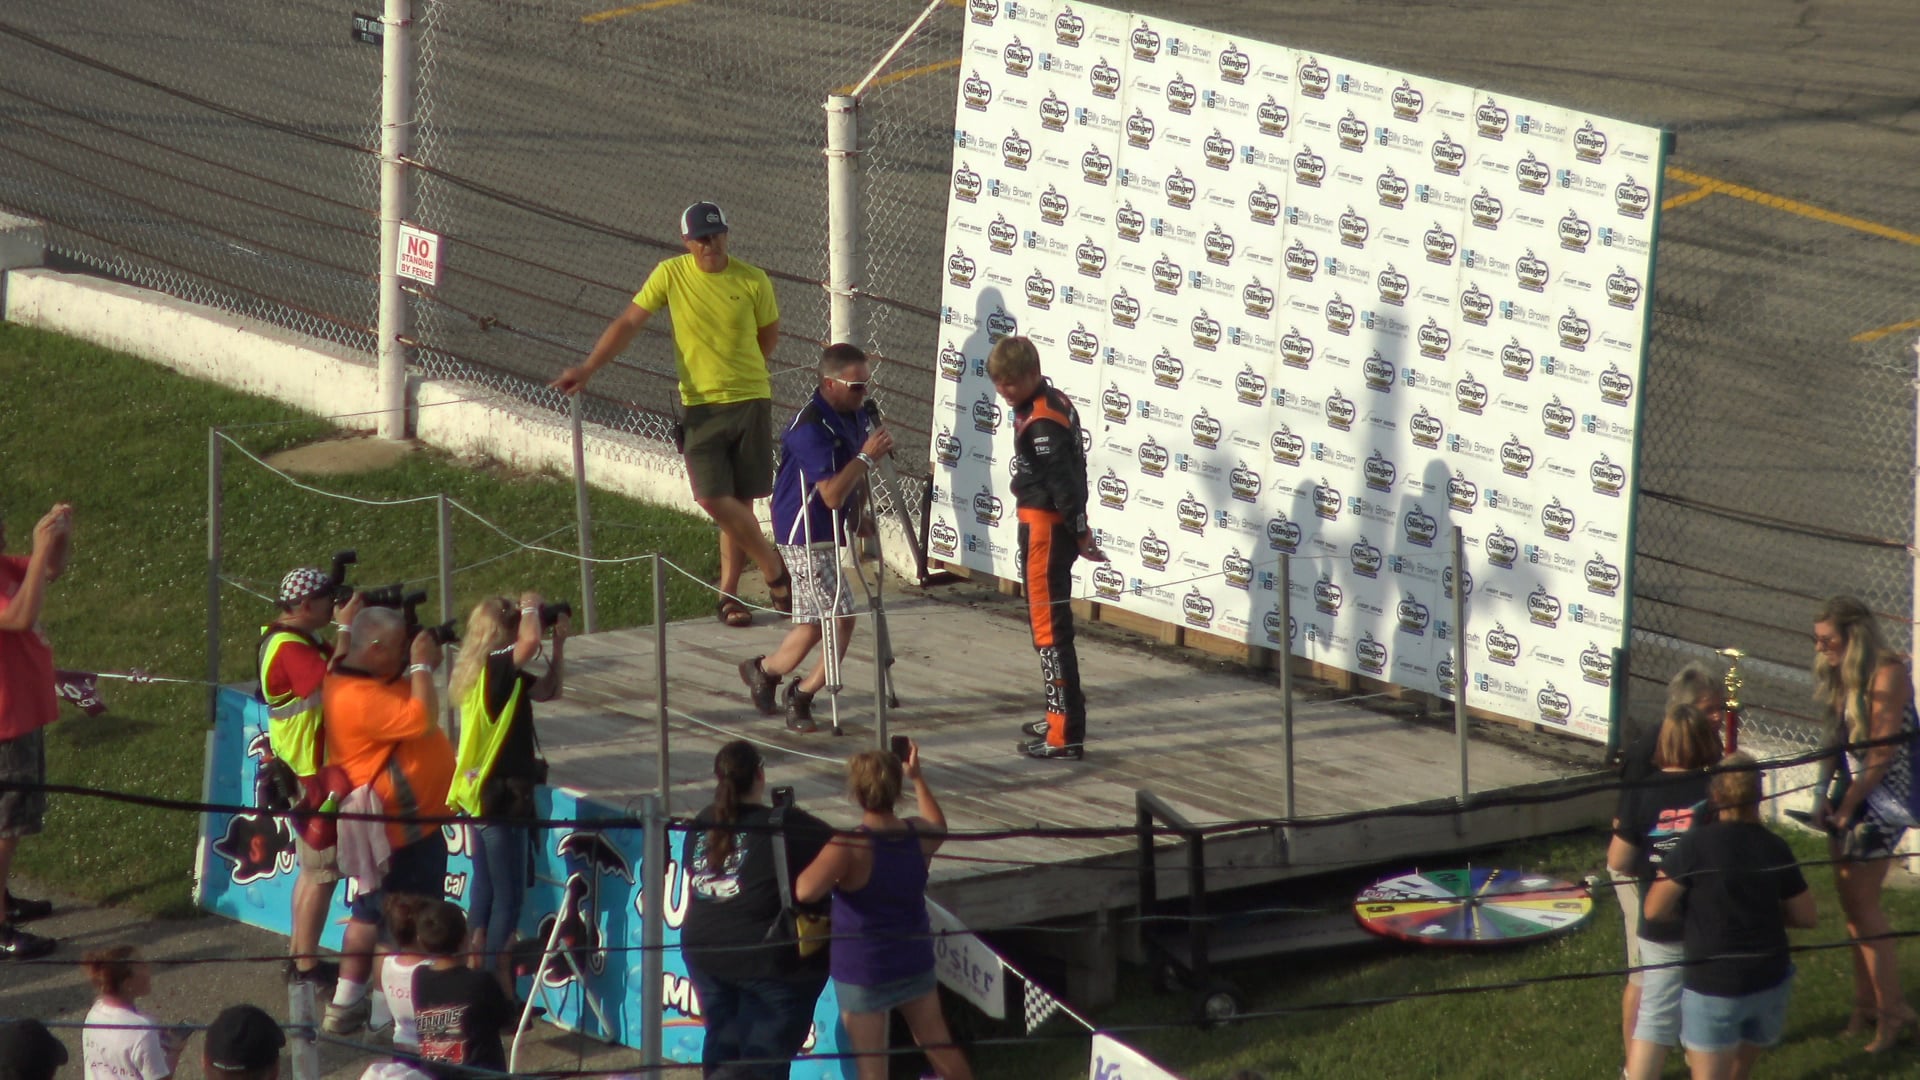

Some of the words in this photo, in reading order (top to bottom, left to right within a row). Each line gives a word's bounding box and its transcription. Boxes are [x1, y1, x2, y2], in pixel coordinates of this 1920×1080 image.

[971, 0, 997, 12] Slinger
[1017, 5, 1028, 18] Billy
[1030, 8, 1049, 21] Brown
[1057, 18, 1081, 32] Slinger
[1133, 34, 1158, 47] Slinger
[1006, 49, 1030, 62] Slinger
[1179, 41, 1190, 54] Billy
[1192, 44, 1212, 57] Brown
[1221, 55, 1247, 69] Slinger
[1093, 70, 1117, 84] Slinger
[1301, 70, 1327, 84] Slinger
[965, 83, 989, 97] Slinger
[1169, 86, 1193, 100] Slinger
[1349, 78, 1361, 91] Billy
[1363, 81, 1383, 94] Brown
[1394, 92, 1420, 107] Slinger
[1042, 103, 1066, 117] Slinger
[1260, 108, 1285, 122] Slinger
[1479, 110, 1505, 125] Slinger
[1088, 111, 1099, 124] Billy
[1101, 114, 1120, 127] Brown
[1339, 123, 1365, 137] Slinger
[1206, 141, 1231, 155] Slinger
[1577, 134, 1603, 148] Slinger
[1004, 142, 1029, 156] Slinger
[1435, 146, 1461, 160] Slinger
[1084, 157, 1109, 171] Slinger
[1254, 149, 1266, 162] Billy
[1268, 153, 1288, 166] Brown
[1296, 158, 1322, 172] Slinger
[1520, 164, 1546, 179] Slinger
[955, 175, 979, 188] Slinger
[1129, 172, 1140, 185] Billy
[1142, 175, 1162, 188] Brown
[1167, 180, 1192, 194] Slinger
[1379, 179, 1405, 194] Slinger
[1570, 173, 1583, 186] Billy
[1585, 176, 1606, 190] Brown
[1000, 182, 1011, 195] Billy
[1013, 186, 1032, 198] Brown
[1429, 188, 1441, 201] Billy
[1443, 191, 1464, 205] Brown
[1618, 188, 1646, 203] Slinger
[1041, 197, 1066, 211] Slinger
[1251, 196, 1276, 210] Slinger
[1473, 200, 1499, 215] Slinger
[1117, 213, 1142, 227] Slinger
[1298, 210, 1310, 223] Billy
[1312, 213, 1332, 227] Brown
[1340, 219, 1366, 233] Slinger
[990, 226, 1014, 240] Slinger
[1561, 222, 1588, 237] Slinger
[1206, 236, 1232, 251] Slinger
[1427, 235, 1453, 250] Slinger
[1612, 231, 1625, 245] Billy
[1627, 235, 1648, 248] Brown
[408, 236, 429, 259] NO
[402, 253, 433, 269] STANDING
[1078, 249, 1103, 263] Slinger
[1288, 252, 1314, 266] Slinger
[1474, 253, 1487, 267] Billy
[1489, 257, 1509, 270] Brown
[401, 264, 411, 272] BY
[412, 267, 432, 280] FENCE
[949, 259, 973, 273] Slinger
[1154, 266, 1179, 280] Slinger
[1519, 262, 1545, 277] Slinger
[1027, 281, 1052, 295] Slinger
[1202, 274, 1213, 287] Billy
[1215, 278, 1235, 291] Brown
[1380, 276, 1406, 291] Slinger
[1609, 279, 1636, 294] Slinger
[1073, 289, 1085, 302] Billy
[1087, 293, 1106, 306] Brown
[1245, 289, 1271, 304] Slinger
[1463, 296, 1489, 310] Slinger
[1112, 299, 1137, 314] Slinger
[1326, 305, 1352, 320] Slinger
[1193, 322, 1218, 336] Slinger
[1560, 321, 1587, 336] Slinger
[1070, 335, 1095, 349] Slinger
[1241, 330, 1252, 344] Billy
[1254, 334, 1274, 347] Brown
[1421, 330, 1447, 345] Slinger
[1284, 340, 1310, 354] Slinger
[1503, 350, 1530, 365] Slinger
[1155, 360, 1180, 374] Slinger
[1238, 377, 1263, 391] Slinger
[1416, 372, 1428, 385] Billy
[1430, 375, 1450, 389] Brown
[1602, 376, 1629, 391] Slinger
[1458, 385, 1484, 400] Slinger
[1103, 395, 1128, 409] Slinger
[1285, 392, 1297, 405] Billy
[1299, 395, 1319, 409] Brown
[1150, 404, 1161, 417] Billy
[1163, 408, 1183, 421] Brown
[1326, 401, 1352, 416] Slinger
[1545, 409, 1572, 424] Slinger
[1193, 420, 1218, 434] Slinger
[1413, 419, 1439, 434] Slinger
[1596, 418, 1609, 432] Billy
[1611, 422, 1632, 436] Brown
[1275, 437, 1301, 451] Slinger
[1140, 448, 1165, 462] Slinger
[1503, 447, 1529, 462] Slinger
[1366, 462, 1393, 477] Slinger
[1593, 466, 1620, 481] Slinger
[1100, 480, 1125, 495] Slinger
[1232, 473, 1258, 488] Slinger
[1498, 493, 1510, 507] Billy
[1512, 497, 1533, 511] Brown
[1179, 504, 1205, 519] Slinger
[1544, 510, 1571, 525] Slinger
[1407, 517, 1434, 532] Slinger
[1142, 542, 1167, 556] Slinger
[1488, 538, 1515, 554] Slinger
[1402, 558, 1414, 572] Billy
[1417, 562, 1437, 576] Brown
[1096, 572, 1121, 586] Slinger
[1185, 598, 1210, 613] Slinger
[1583, 607, 1596, 621] Billy
[1598, 611, 1619, 626] Brown
[1489, 635, 1516, 650] Slinger
[1489, 677, 1501, 691] Billy
[1503, 681, 1524, 695] Brown
[1540, 694, 1567, 709] Slinger
